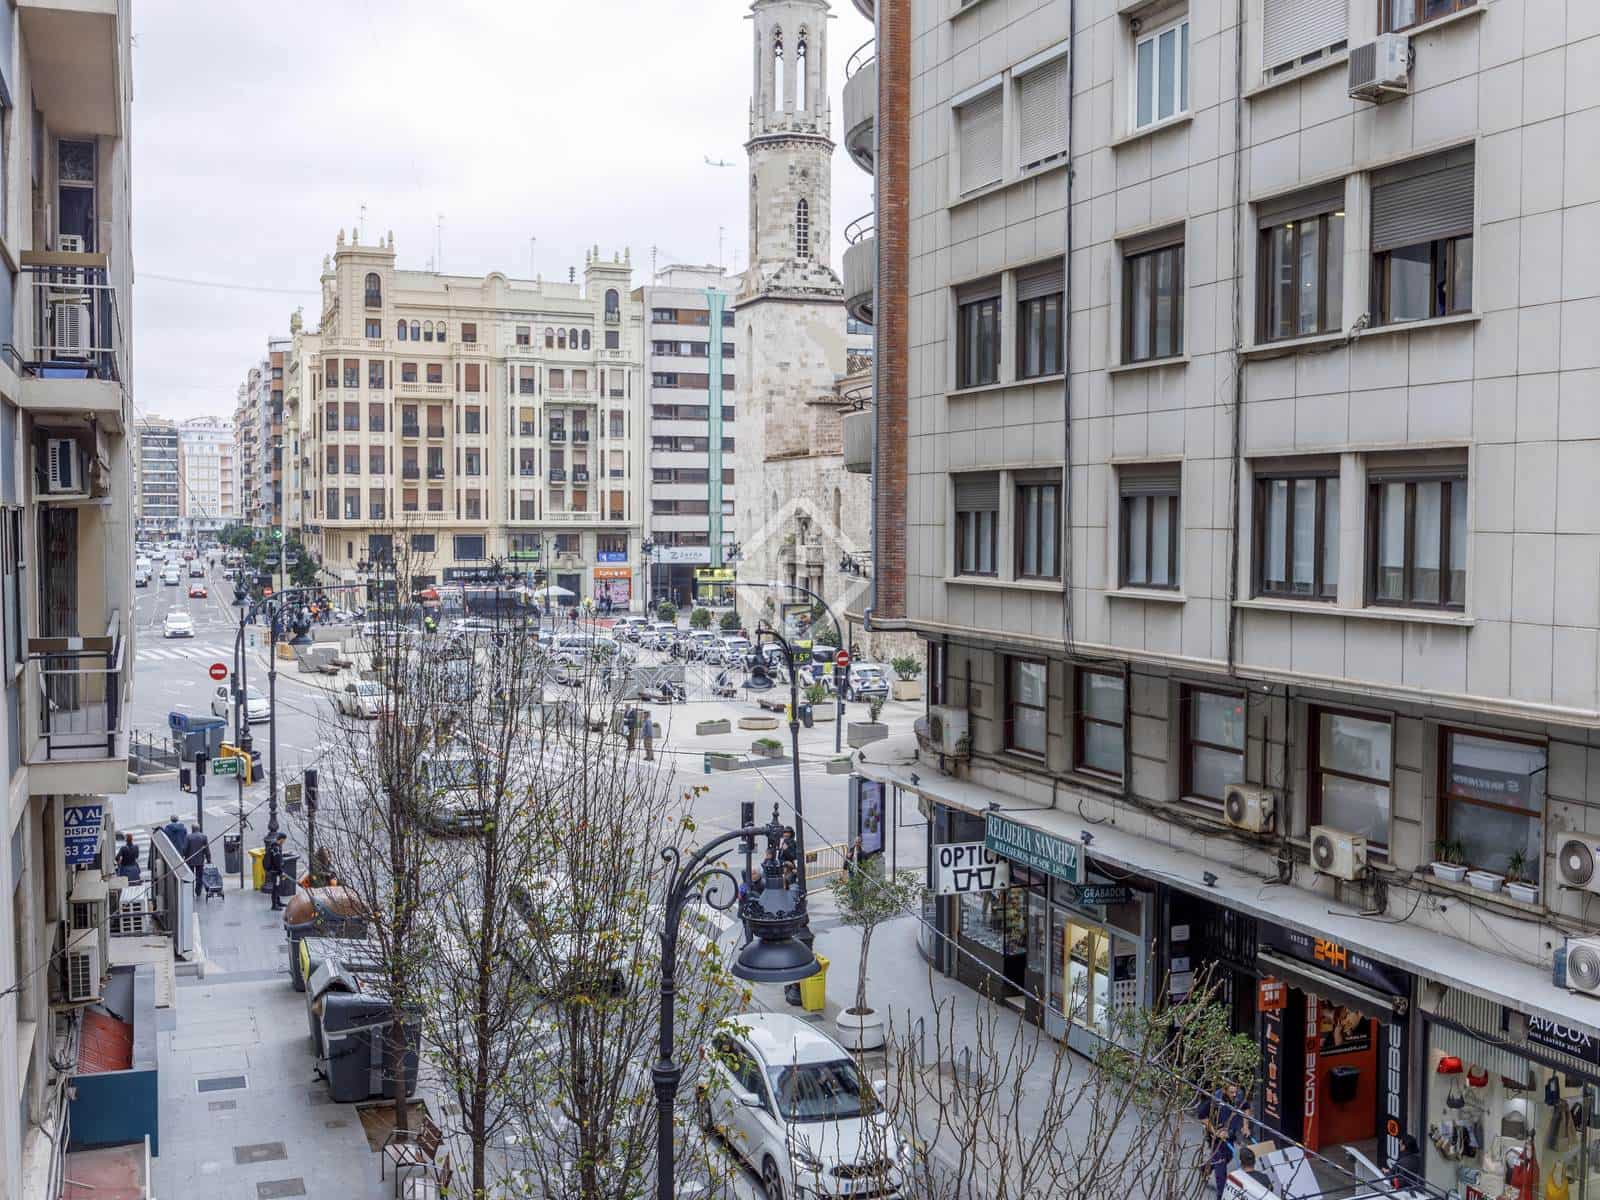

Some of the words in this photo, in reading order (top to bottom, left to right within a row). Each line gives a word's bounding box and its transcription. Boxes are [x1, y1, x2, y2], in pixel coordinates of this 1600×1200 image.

[1035, 833, 1076, 868] SANCHEZ
[1314, 936, 1348, 971] 24H
[1305, 1053, 1316, 1118] COME
[1387, 1024, 1401, 1118] BEBE
